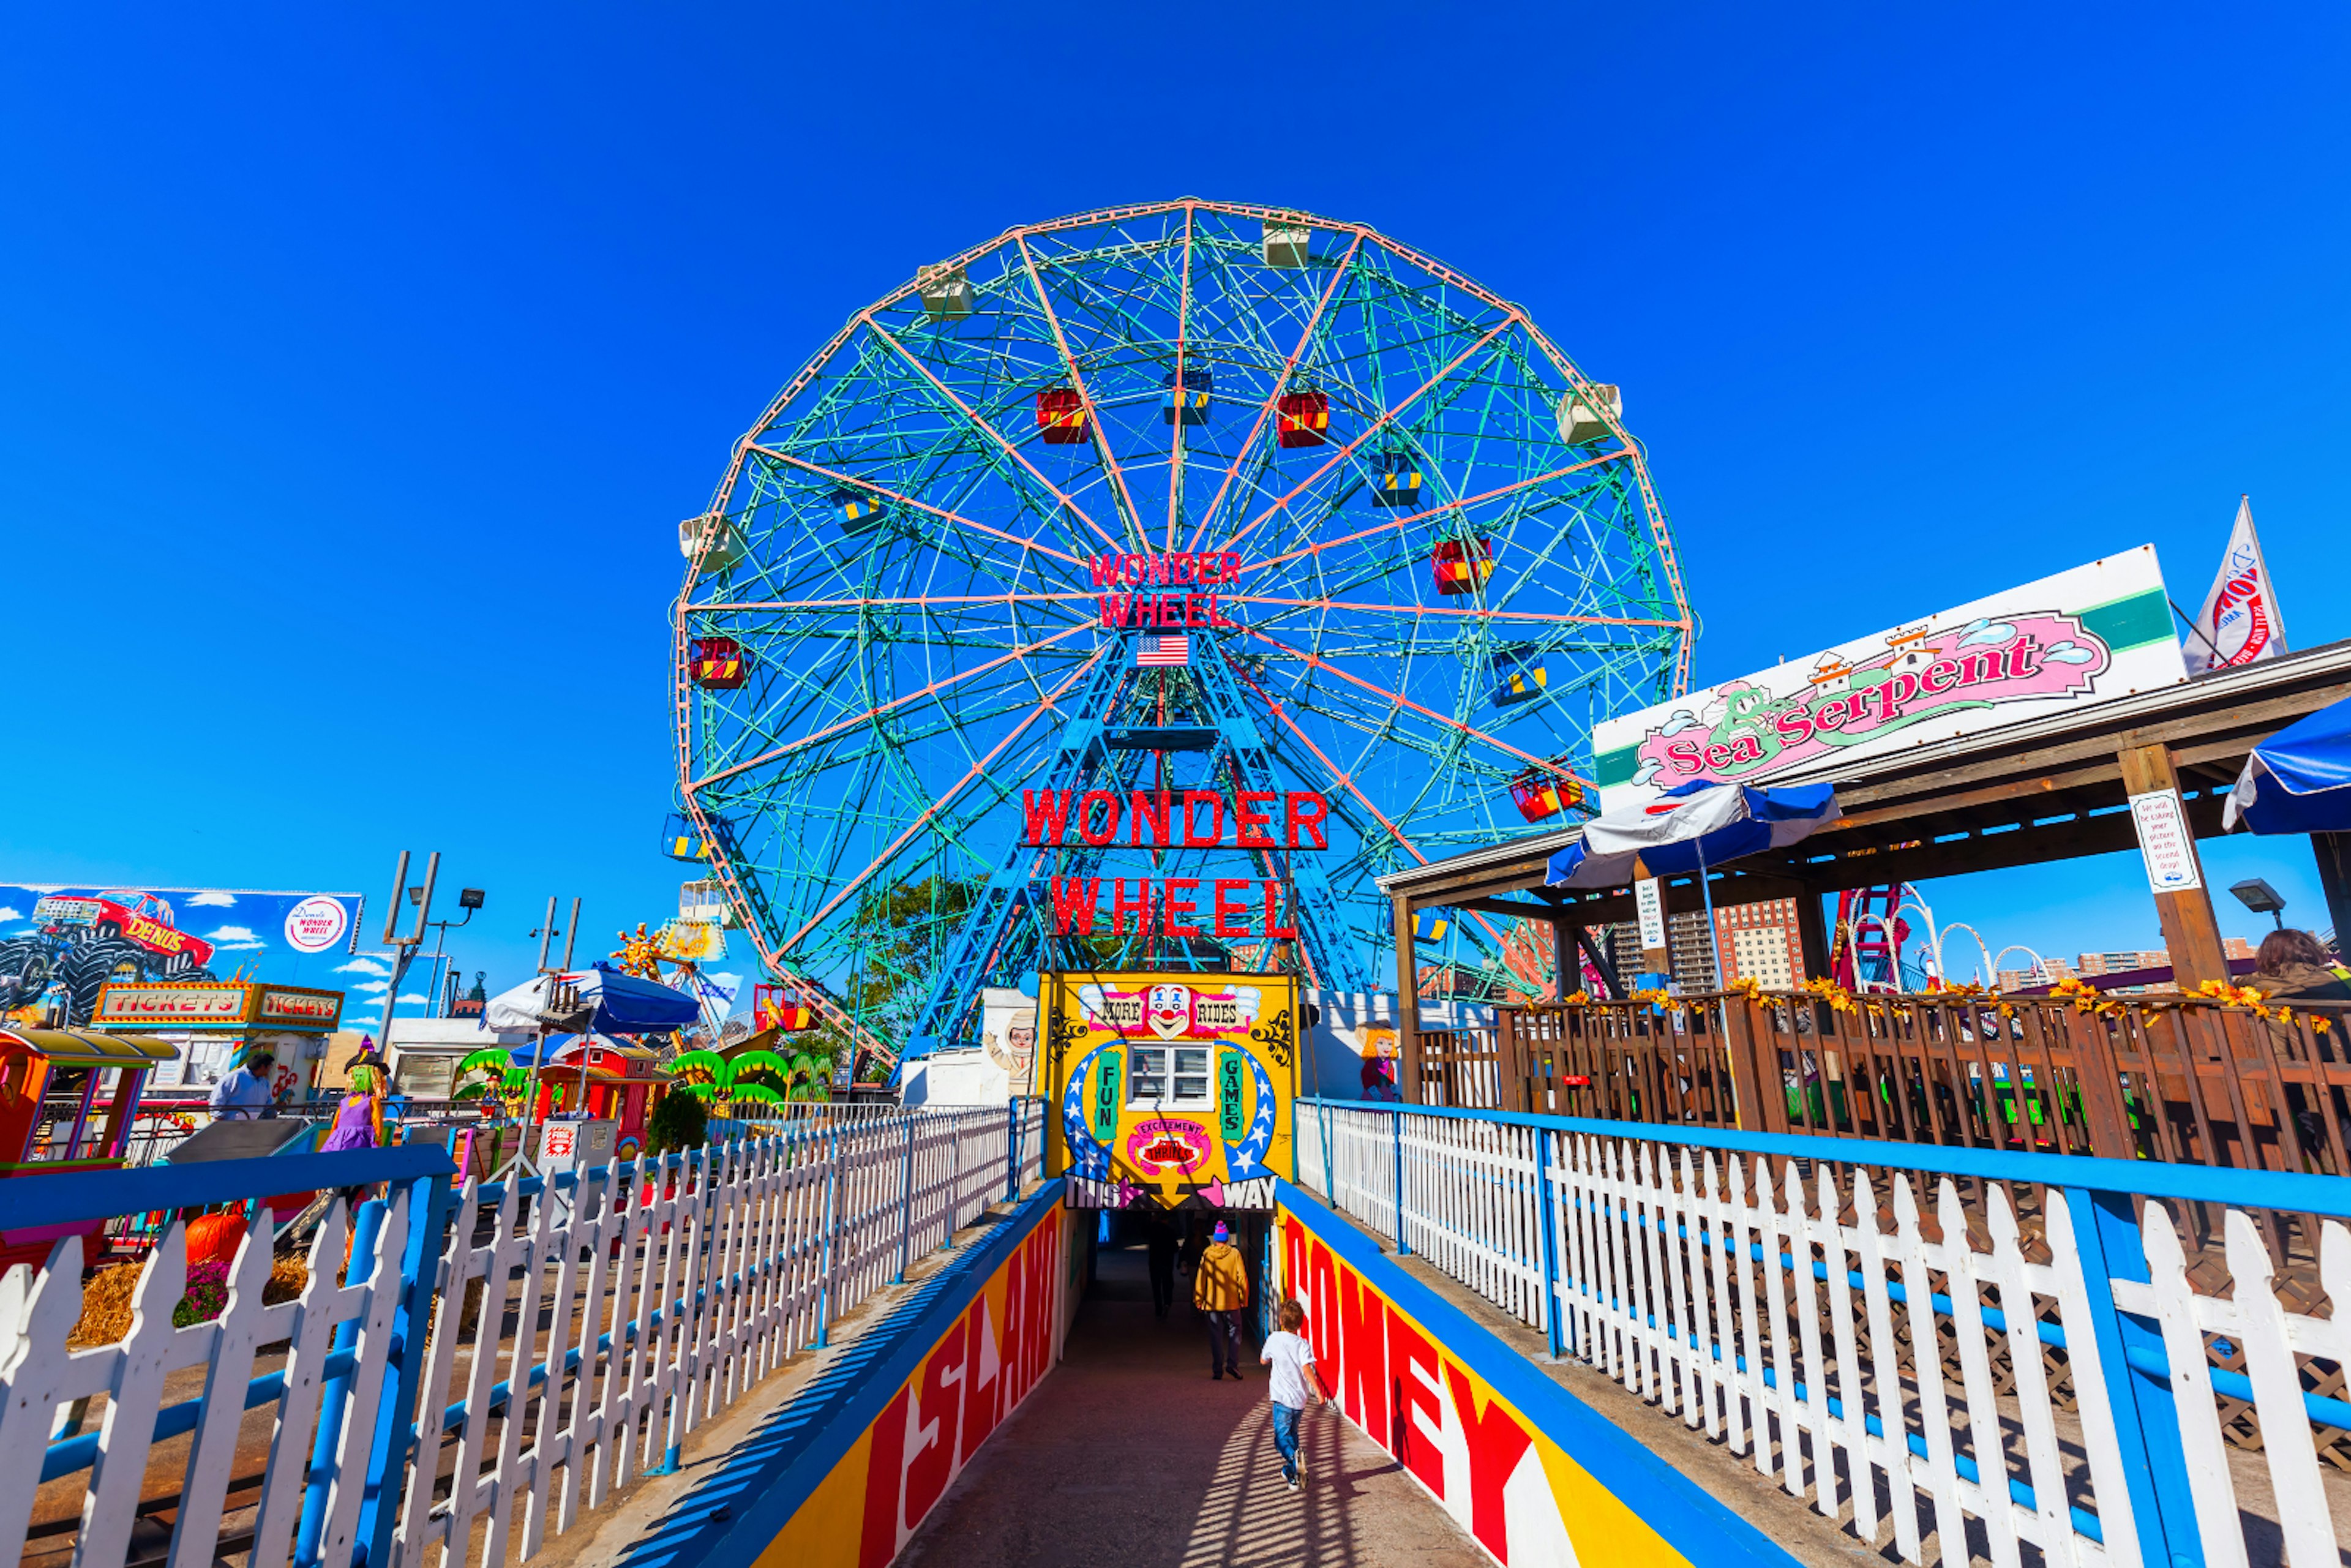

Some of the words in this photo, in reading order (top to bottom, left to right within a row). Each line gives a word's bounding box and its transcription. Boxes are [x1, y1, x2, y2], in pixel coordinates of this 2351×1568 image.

[1090, 552, 1241, 586] WONDER
[1099, 593, 1231, 628] WHEEL
[1666, 737, 1766, 775] Sea
[1776, 632, 2045, 748] Serpent
[1023, 789, 1328, 848] WONDER
[1051, 877, 1295, 938] WHEEL
[113, 994, 235, 1012] TICKETS
[266, 995, 336, 1016] TICKETS
[1102, 1002, 1141, 1021] MORE
[1197, 1003, 1237, 1024] RIDES
[1100, 1067, 1114, 1127] FUN
[1224, 1060, 1240, 1130] GAMES
[1141, 1120, 1201, 1135] EXCITEMENT
[1065, 1174, 1121, 1207] THIS
[1221, 1175, 1280, 1209] WAY
[859, 1207, 1057, 1568] ISLAND
[1286, 1214, 1533, 1568] CONEY
